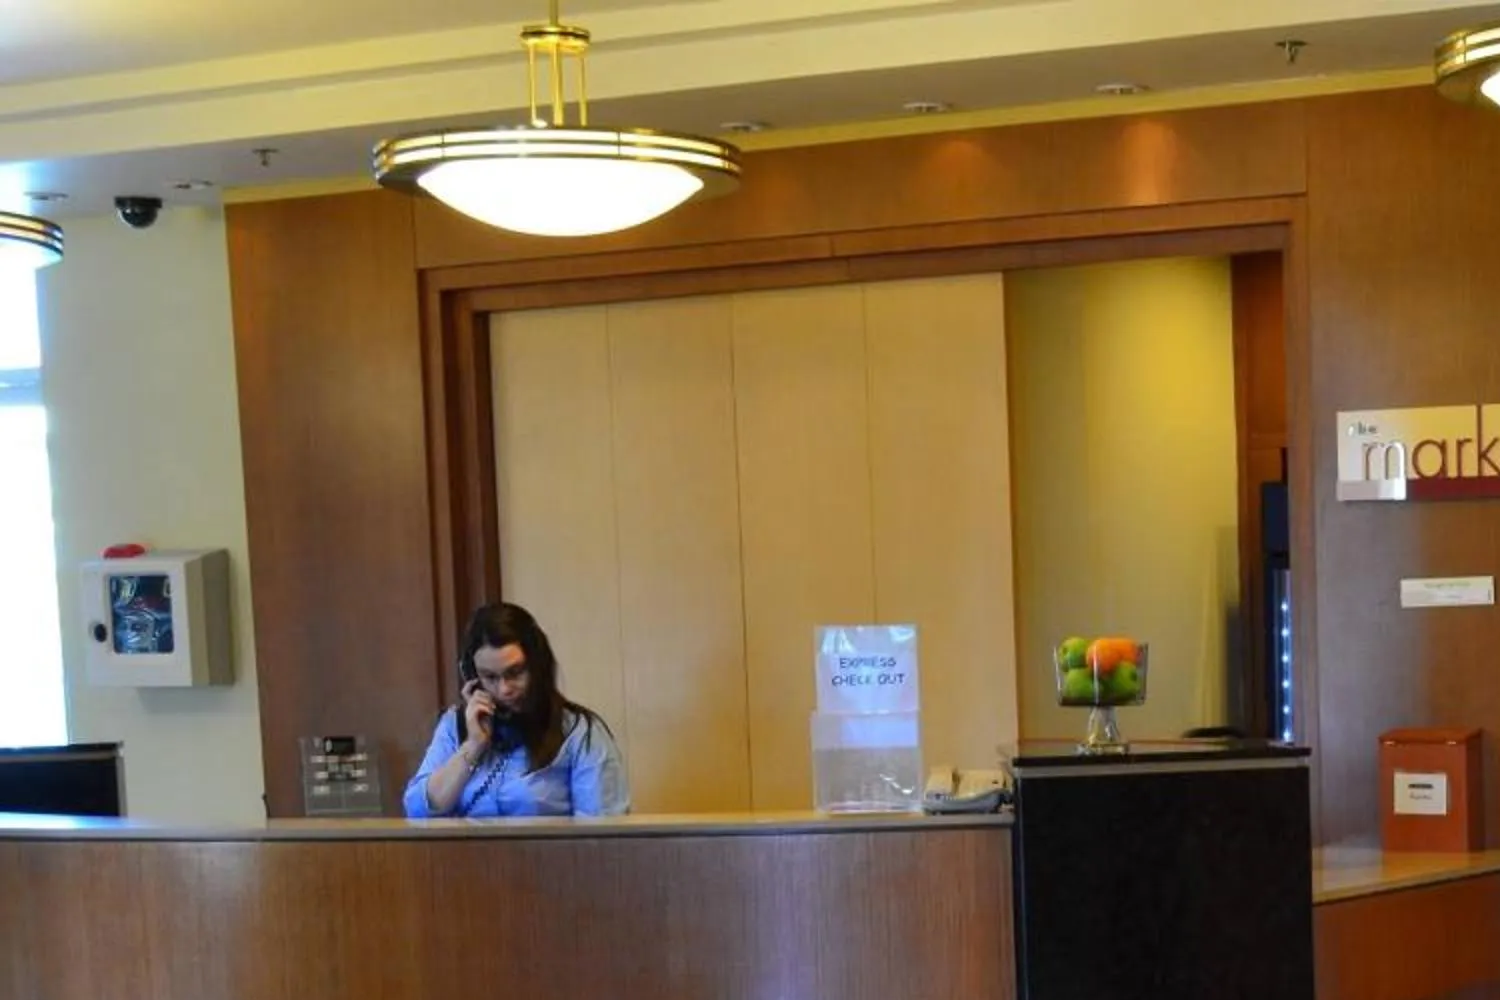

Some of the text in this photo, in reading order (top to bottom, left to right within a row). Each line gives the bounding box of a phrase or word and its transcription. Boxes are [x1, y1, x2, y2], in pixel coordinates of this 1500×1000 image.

[839, 657, 897, 669] EXPRESS
[831, 672, 905, 687] CHECK OUT
